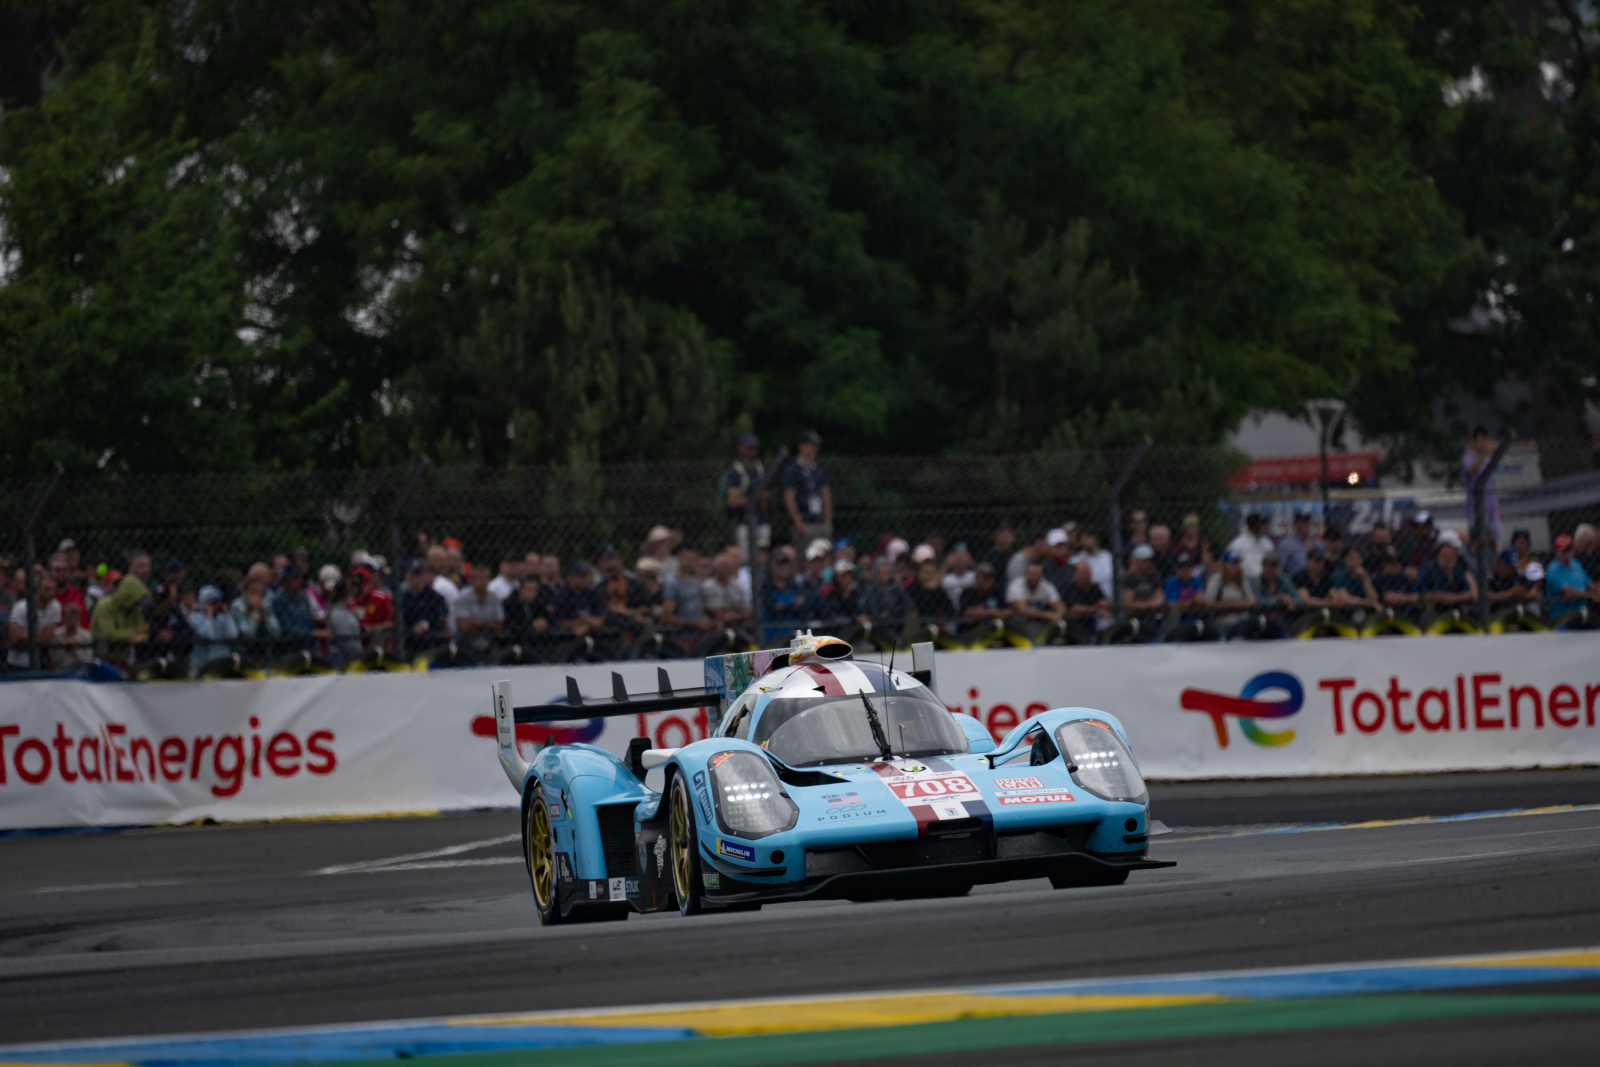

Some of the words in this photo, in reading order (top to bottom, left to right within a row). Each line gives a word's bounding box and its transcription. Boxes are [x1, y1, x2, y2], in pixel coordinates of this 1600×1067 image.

[0, 715, 337, 798] TotalEnergies
[891, 778, 973, 797] 708
[1004, 794, 1071, 804] MOTUL
[817, 809, 886, 822] PODIUM
[726, 846, 750, 857] MICHELIN
